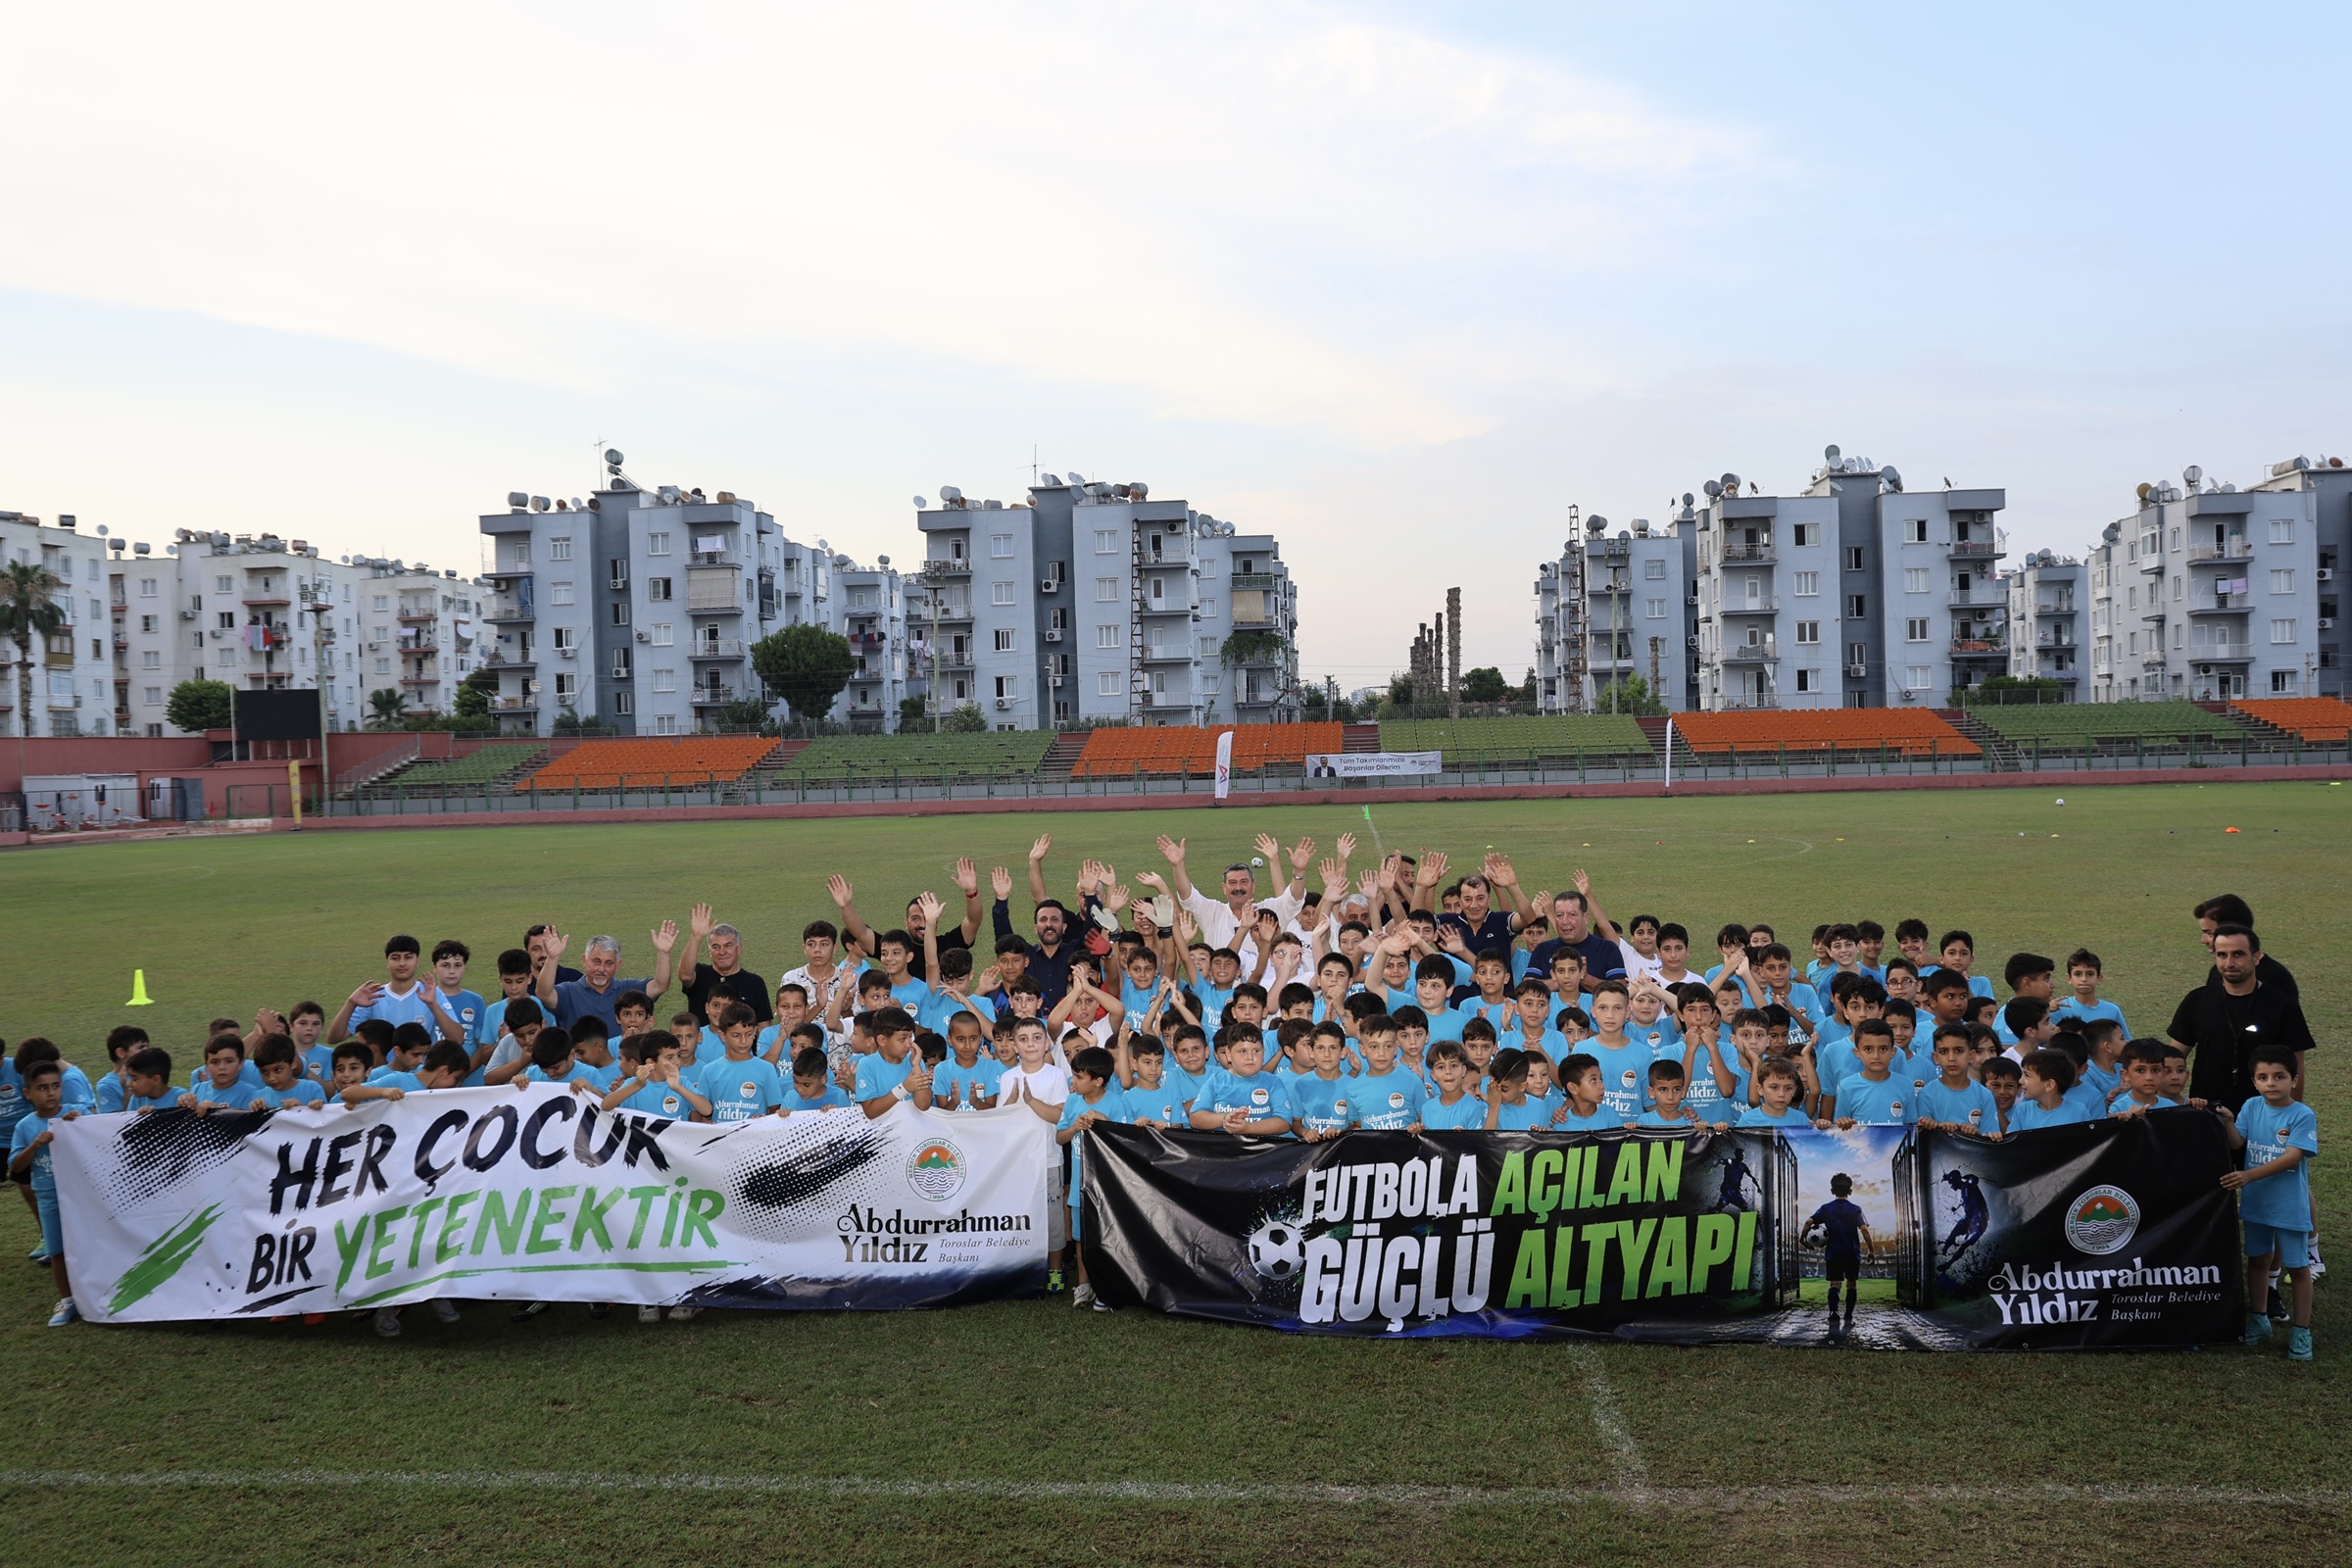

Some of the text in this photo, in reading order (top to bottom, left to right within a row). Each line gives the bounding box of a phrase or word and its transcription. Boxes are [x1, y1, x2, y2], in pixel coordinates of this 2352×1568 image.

[1356, 756, 1404, 764] Takımlarımıza
[717, 1106, 751, 1120] Yıldız
[269, 1095, 677, 1215] HER ÇOCUK
[2246, 1139, 2286, 1154] bdurrahm
[2247, 1148, 2277, 1164] Yıld
[1301, 1140, 1687, 1225] FUTBOLA AÇILAN
[2078, 1189, 2113, 1207] TOROSLAR
[837, 1203, 1031, 1235] Abdurrahman
[245, 1176, 725, 1298] BİR YETENEKTİR
[839, 1235, 1031, 1263] Yıldız Toroslar Belediye
[938, 1253, 980, 1265] Başkanı
[1298, 1211, 1758, 1333] GÜÇLÜ ALTYAPI
[1987, 1256, 2222, 1292] Abdurrahman
[1989, 1291, 2222, 1325] Yıldız Toroslar Belediye
[2111, 1309, 2162, 1322] Başkanı
